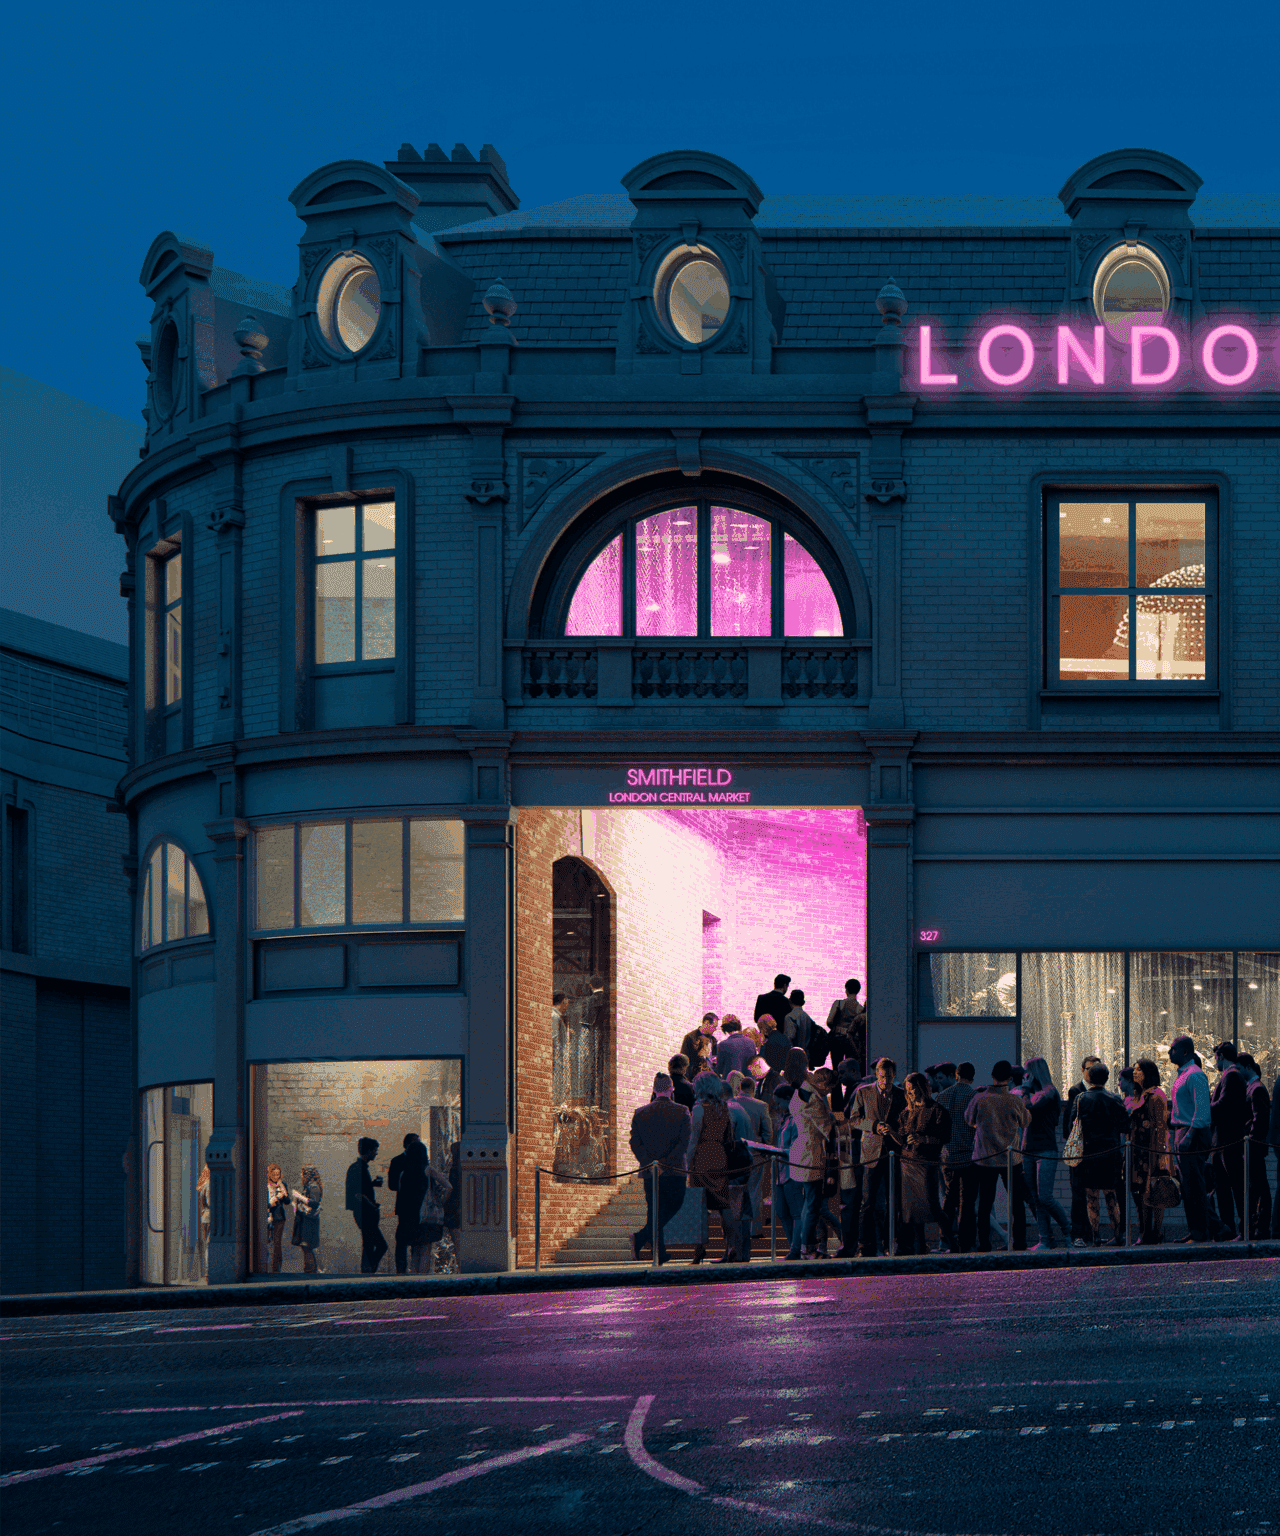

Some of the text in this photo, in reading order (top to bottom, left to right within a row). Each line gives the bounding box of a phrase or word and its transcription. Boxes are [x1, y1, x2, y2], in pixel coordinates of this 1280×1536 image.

[627, 768, 732, 786] SMITHFIELD
[609, 792, 750, 802] LONDON CENTRAL MARKET
[920, 930, 939, 941] 327
